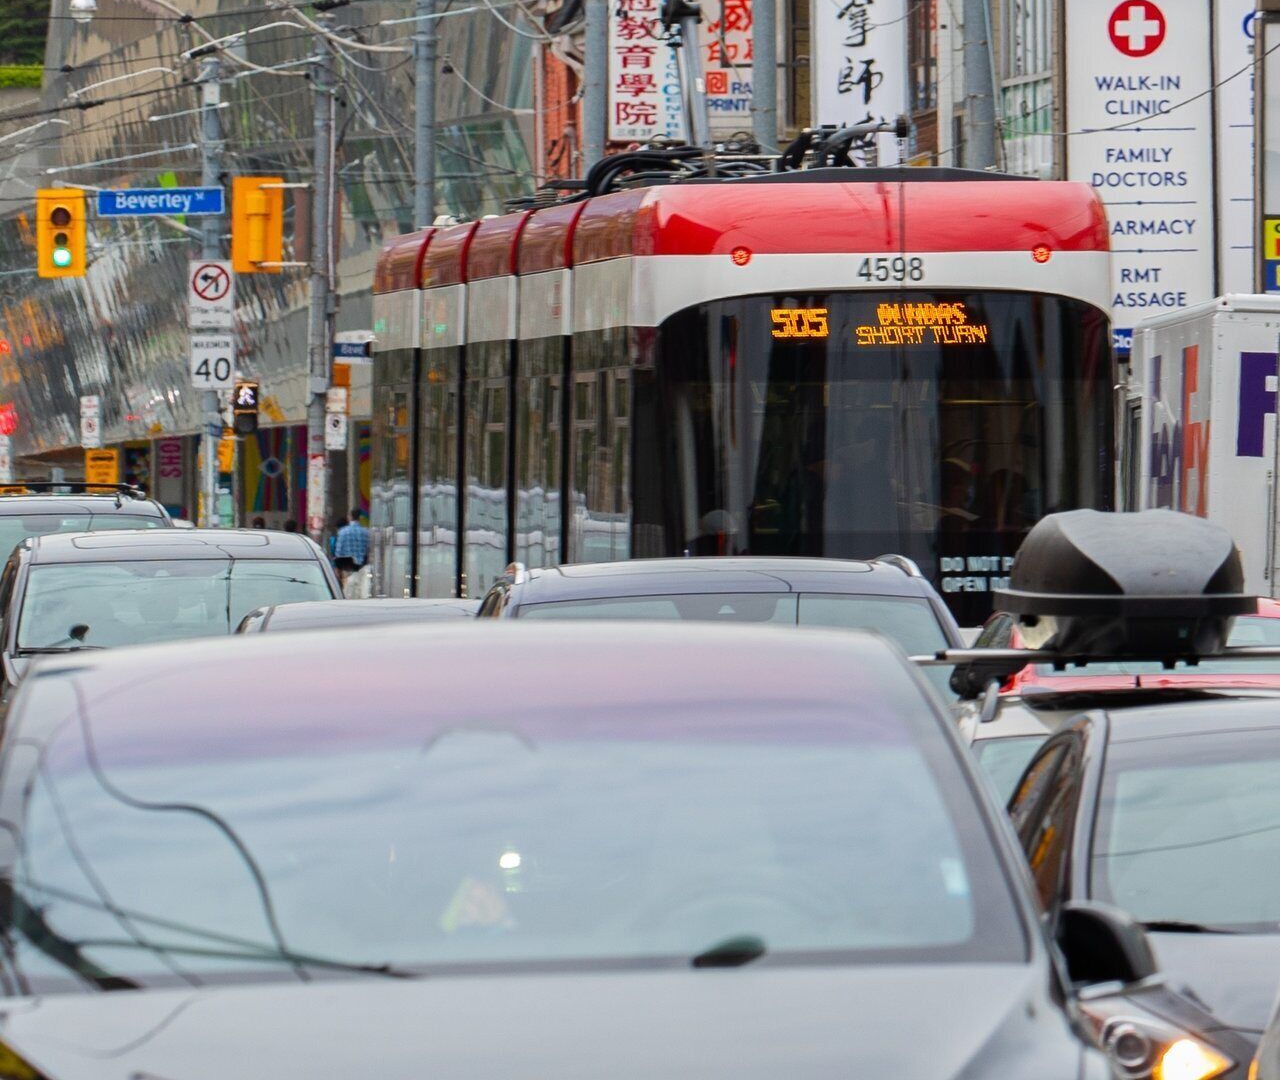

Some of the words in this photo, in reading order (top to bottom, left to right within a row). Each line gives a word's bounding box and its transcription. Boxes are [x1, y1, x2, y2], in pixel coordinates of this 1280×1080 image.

[1095, 76, 1181, 91] WALK-IN
[1105, 100, 1171, 115] CLINIC
[1106, 148, 1172, 163] FAMILY
[1091, 171, 1188, 188] DOCTORS
[115, 192, 192, 212] Beverley
[1110, 219, 1196, 235] ARMACY
[858, 257, 924, 282] 4598
[1120, 269, 1161, 283] RMT
[1111, 292, 1187, 308] ASSAGE
[768, 307, 830, 338] 505
[856, 324, 923, 345] SHORT
[194, 356, 232, 382] 40
